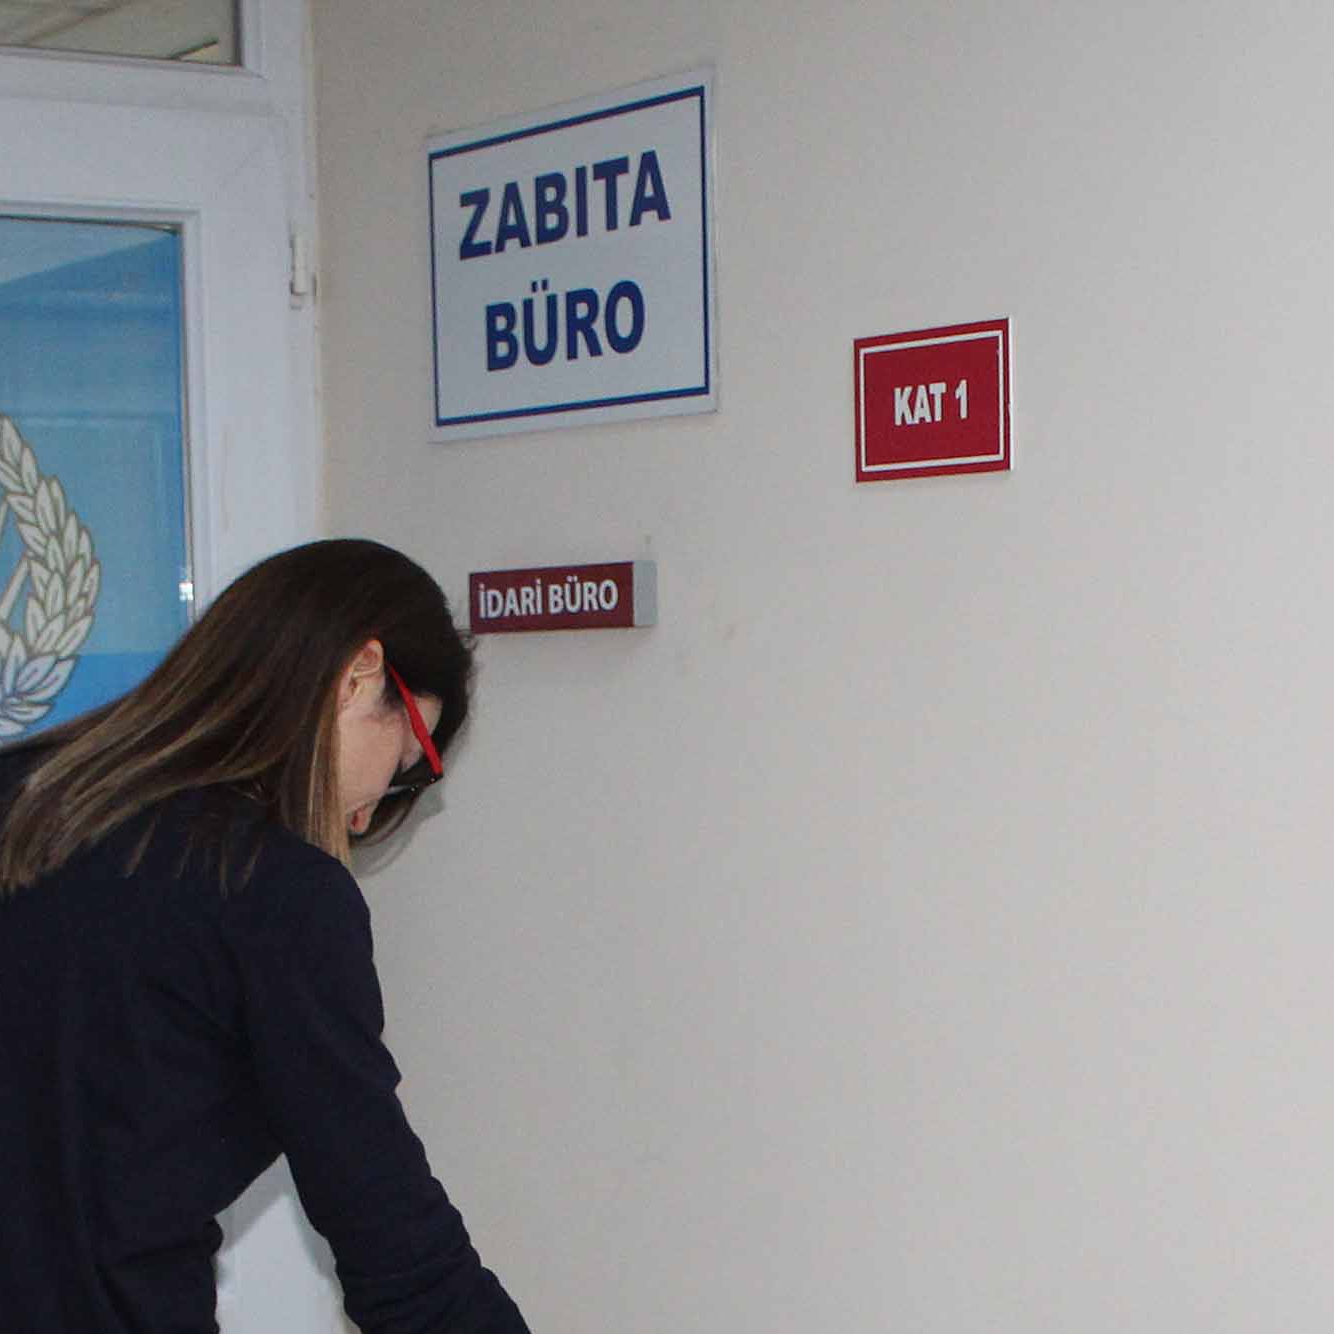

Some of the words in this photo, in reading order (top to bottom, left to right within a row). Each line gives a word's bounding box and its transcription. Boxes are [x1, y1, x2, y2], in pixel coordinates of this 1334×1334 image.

[459, 149, 671, 260] ZABITA
[485, 279, 645, 372] BÜRO
[894, 382, 946, 426] KAT
[954, 379, 969, 421] 1
[479, 581, 544, 621] İDARİ
[547, 575, 619, 615] BÜRO
